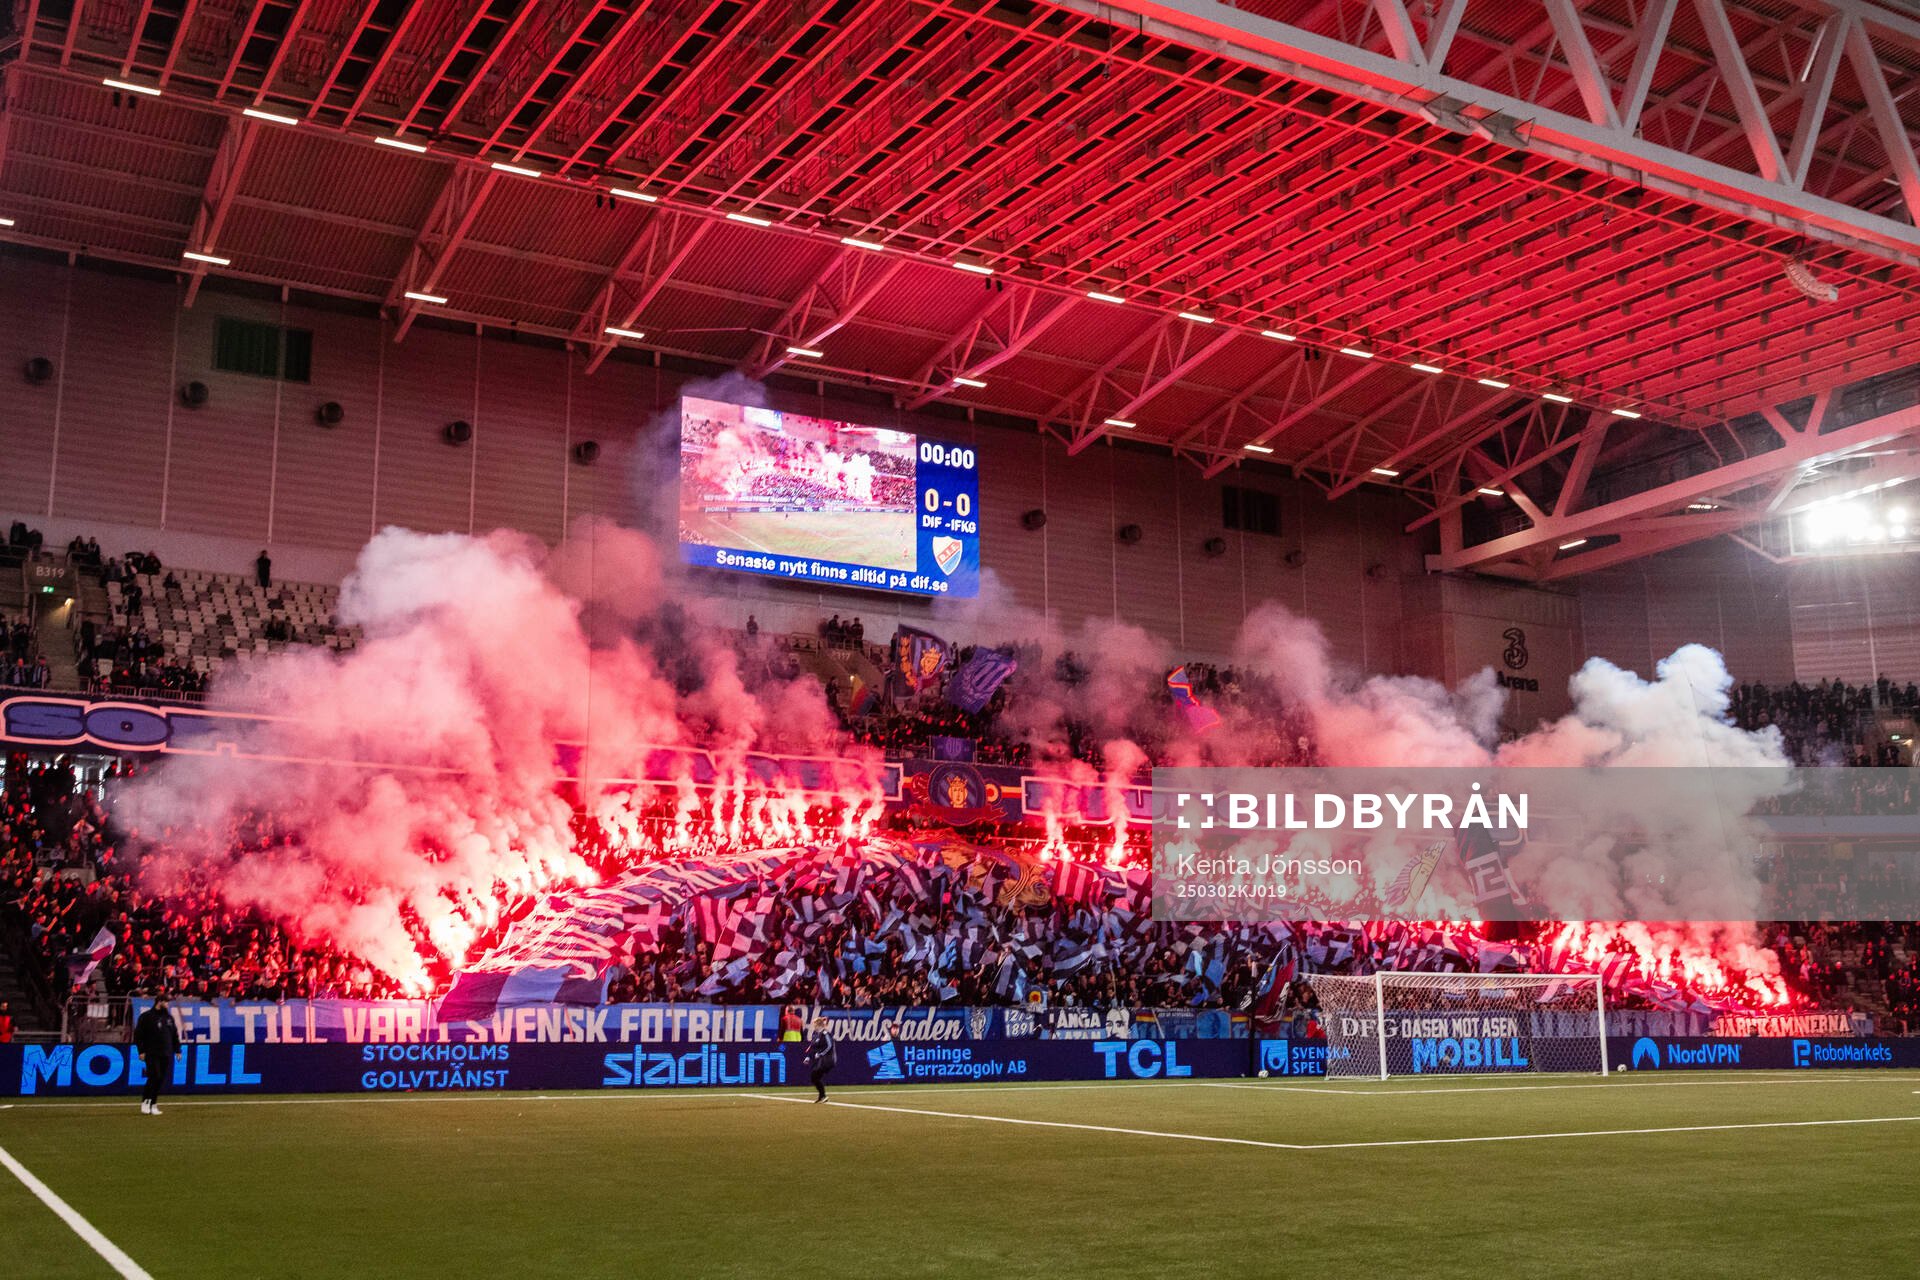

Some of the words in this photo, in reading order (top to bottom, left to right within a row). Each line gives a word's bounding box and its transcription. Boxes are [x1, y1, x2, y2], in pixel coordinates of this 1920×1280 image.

[920, 442, 975, 470] 00:00
[924, 488, 939, 512] 0
[956, 493, 971, 517] 0
[922, 514, 942, 529] DIF
[36, 566, 65, 578] B319
[716, 550, 776, 571] Senaste
[780, 560, 808, 576] nytt
[811, 561, 848, 581] finns
[851, 567, 886, 585] alltid
[889, 572, 907, 589] på
[910, 574, 949, 592] dif.se
[1496, 671, 1539, 692] Arena
[235, 1006, 328, 1043] TILL
[343, 1007, 421, 1043] VAR
[465, 1007, 609, 1043] SVENSK
[620, 1008, 772, 1042] FOTBOLL
[1341, 1018, 1400, 1038] DFG
[1452, 1017, 1479, 1038] MOT
[362, 1044, 510, 1061] STOCKHOLMS
[904, 1045, 972, 1063] Haninge
[1093, 1039, 1192, 1078] TCL
[1292, 1046, 1350, 1061] SVENSKA
[1411, 1037, 1529, 1073] MOBILL
[1667, 1043, 1741, 1064] NordVPN
[1814, 1043, 1893, 1063] RoboMarkets
[361, 1062, 509, 1089] GOLVTJÄNST
[603, 1044, 786, 1086] stadium
[905, 1060, 1003, 1079] Terrazzogolv
[1007, 1060, 1027, 1074] AB
[1292, 1061, 1324, 1075] SPEL
